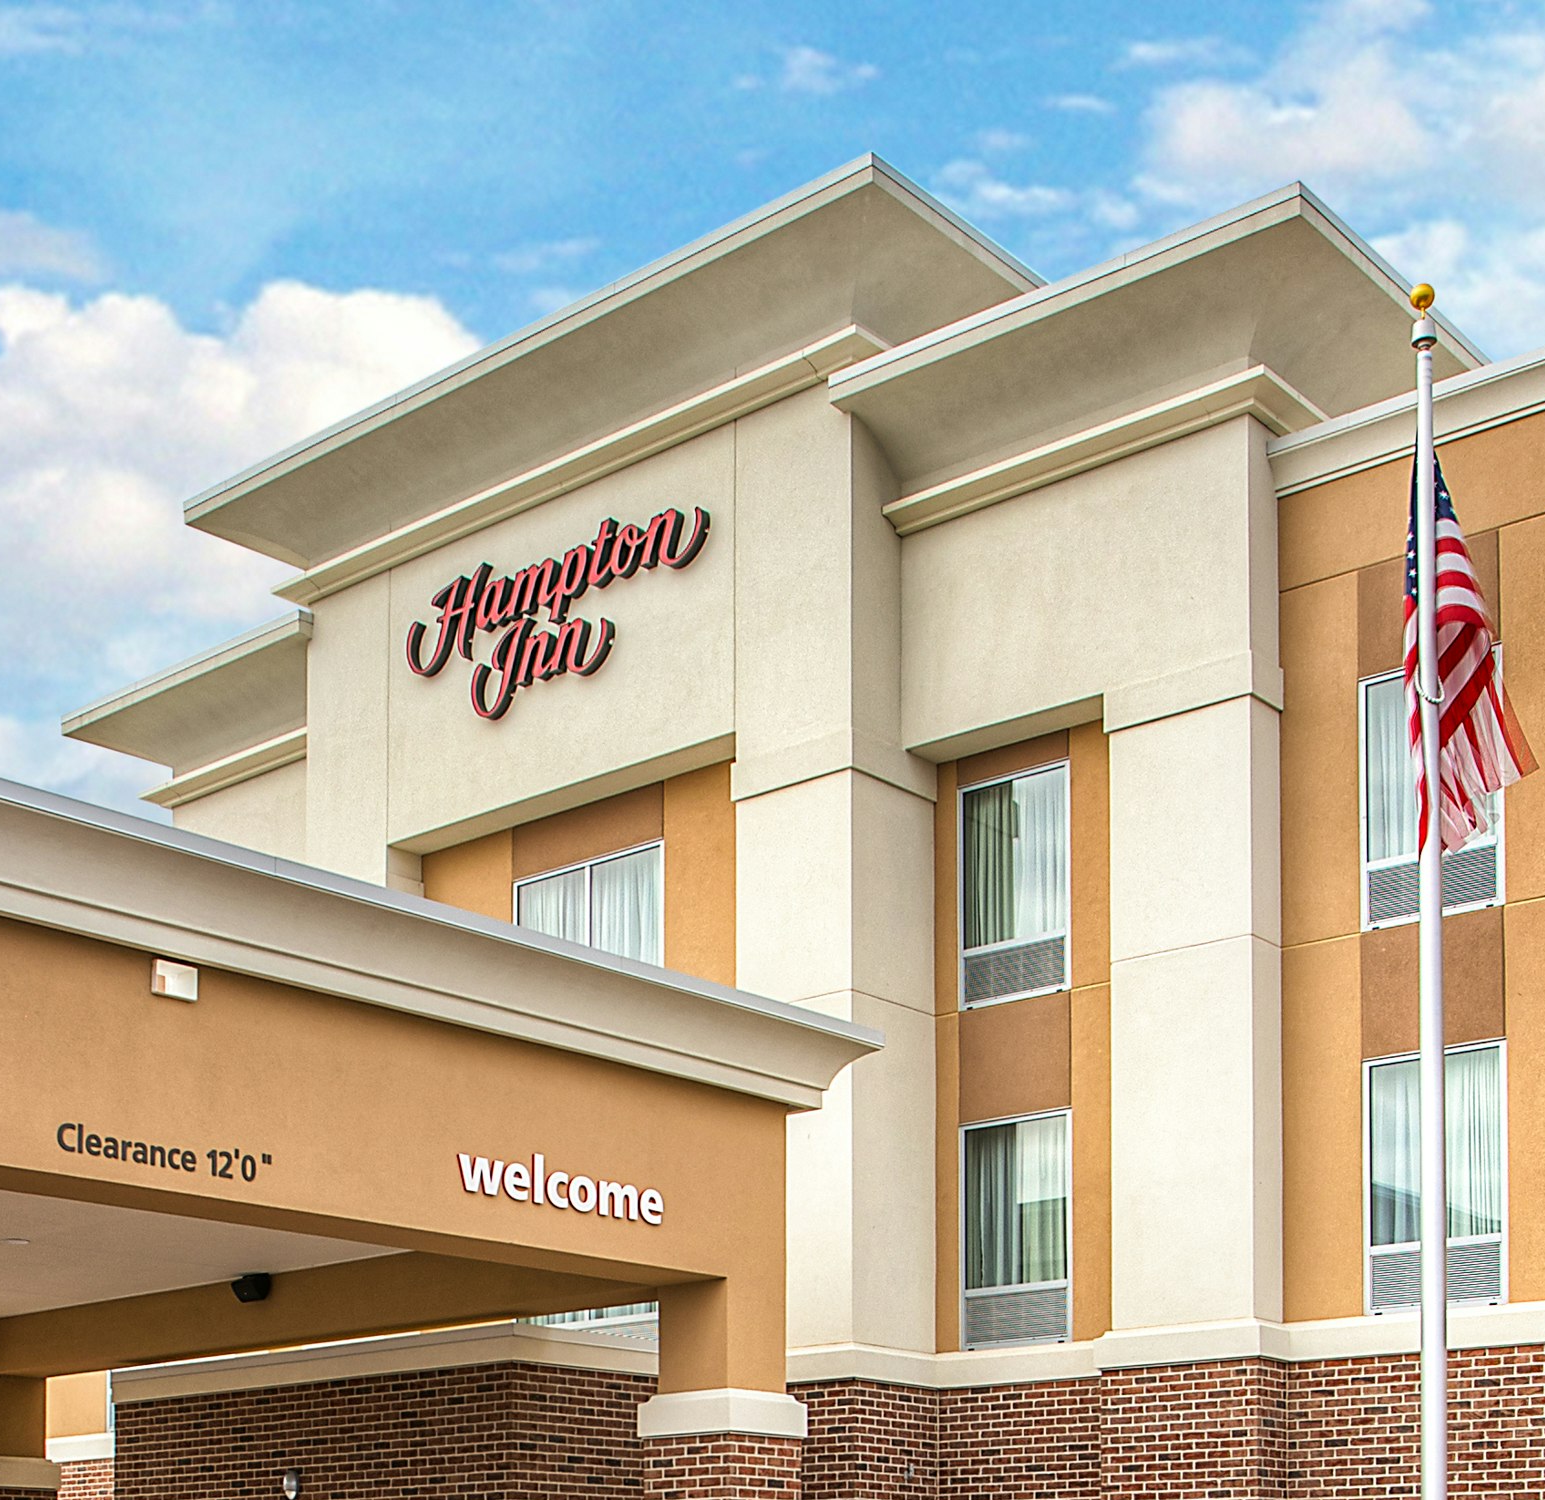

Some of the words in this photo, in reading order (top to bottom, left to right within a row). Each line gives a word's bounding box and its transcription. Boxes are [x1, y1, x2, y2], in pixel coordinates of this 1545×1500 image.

[406, 506, 711, 678] Hampton
[470, 617, 616, 721] Inn
[56, 1122, 197, 1172] Clearance
[457, 1152, 664, 1226] welcome
